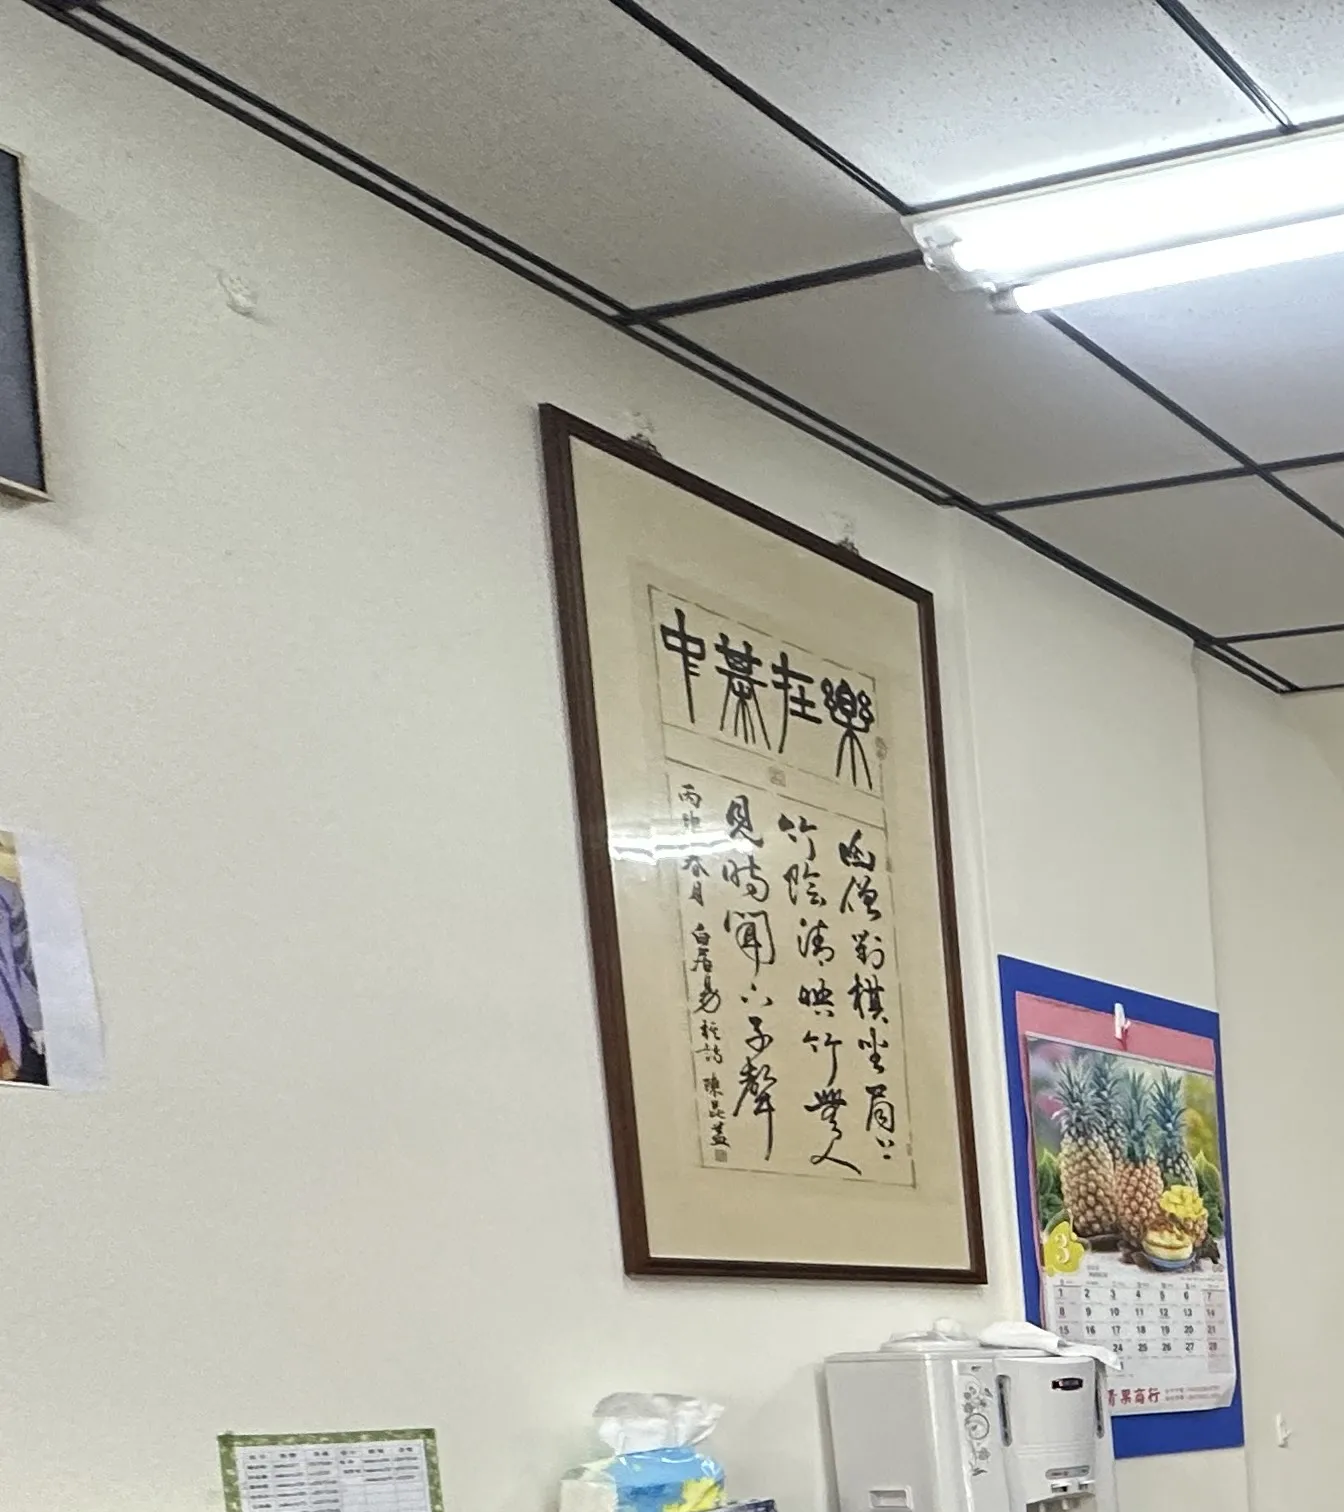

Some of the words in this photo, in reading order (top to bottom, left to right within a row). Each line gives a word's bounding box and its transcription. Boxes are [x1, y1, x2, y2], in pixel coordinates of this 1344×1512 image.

[1057, 1234, 1070, 1264] 3
[1058, 1289, 1063, 1297] 1
[1084, 1289, 1090, 1297] 2
[1111, 1289, 1116, 1298] 3
[1136, 1290, 1141, 1298] 4
[1160, 1291, 1165, 1299] 5
[1184, 1291, 1189, 1300] 6
[1086, 1308, 1091, 1316] 9
[1110, 1308, 1119, 1316] 10
[1135, 1308, 1143, 1316] 11
[1059, 1326, 1069, 1334] 15
[1086, 1326, 1095, 1334] 16
[1112, 1326, 1120, 1335] 17
[1161, 1326, 1170, 1334] 19
[1184, 1326, 1194, 1334] 20
[1208, 1326, 1216, 1334] 21
[1138, 1343, 1147, 1351] 25
[1162, 1343, 1171, 1351] 26
[1186, 1343, 1194, 1351] 27
